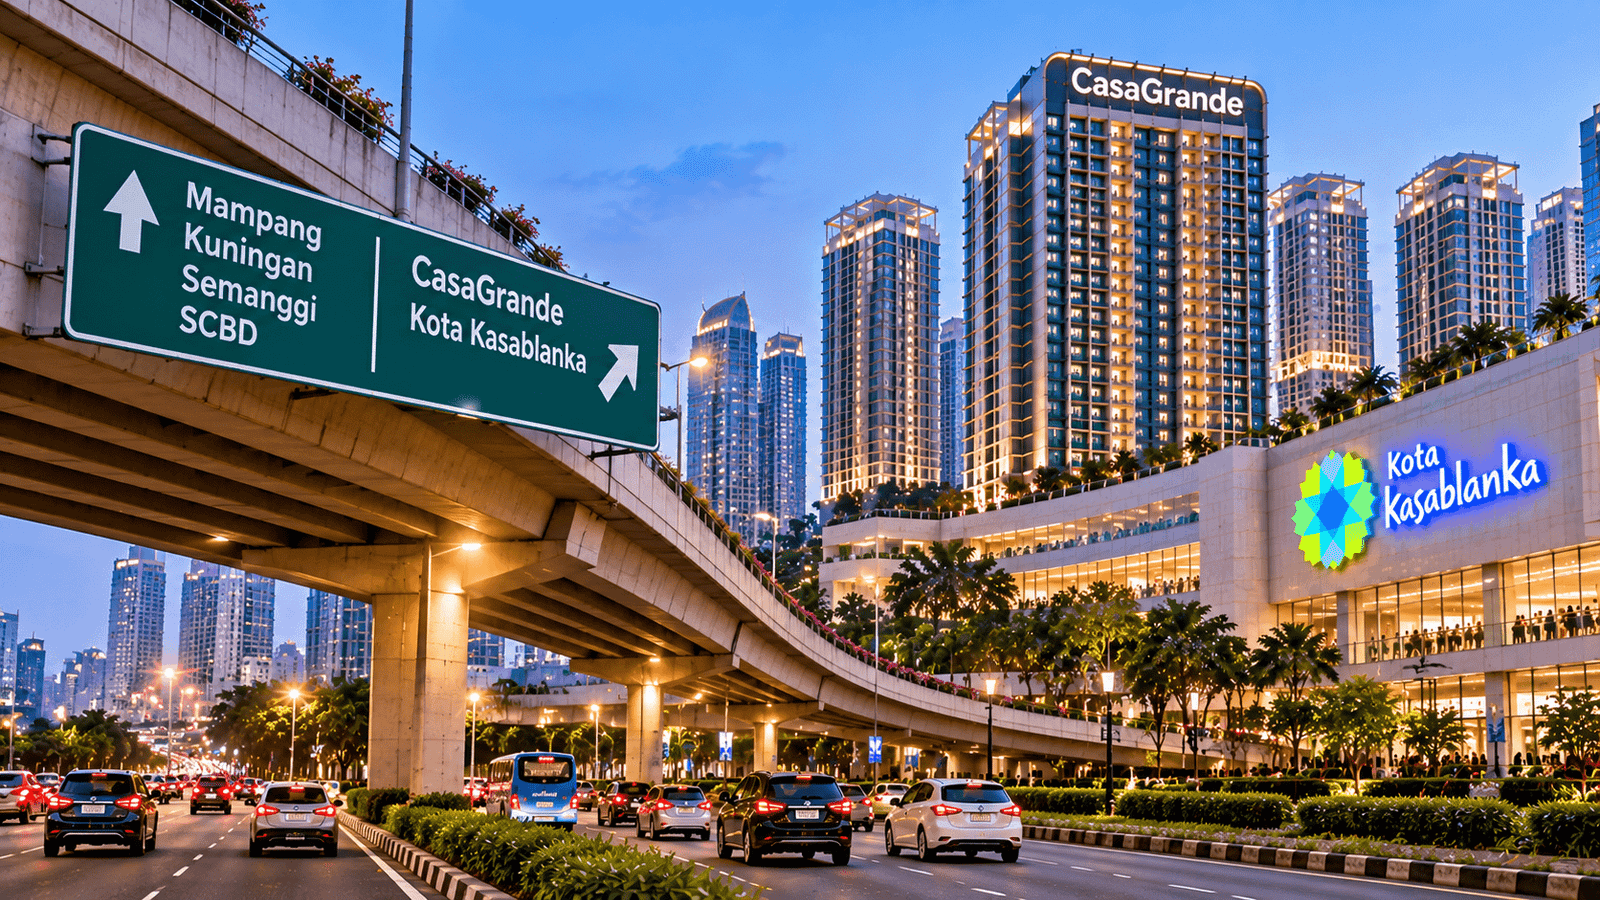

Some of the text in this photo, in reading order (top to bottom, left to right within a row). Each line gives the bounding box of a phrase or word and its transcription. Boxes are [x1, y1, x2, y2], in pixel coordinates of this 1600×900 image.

[1071, 66, 1244, 116] CasaGrande
[186, 180, 322, 253] Mampang
[184, 222, 313, 283] Kuningan
[181, 264, 317, 326] Semanggi
[411, 254, 565, 327] CasaGrande
[179, 305, 259, 347] SCBD
[409, 303, 587, 375] Kota Kasablanka
[1384, 442, 1541, 529] Kasablanka
[1387, 443, 1440, 480] Kota
